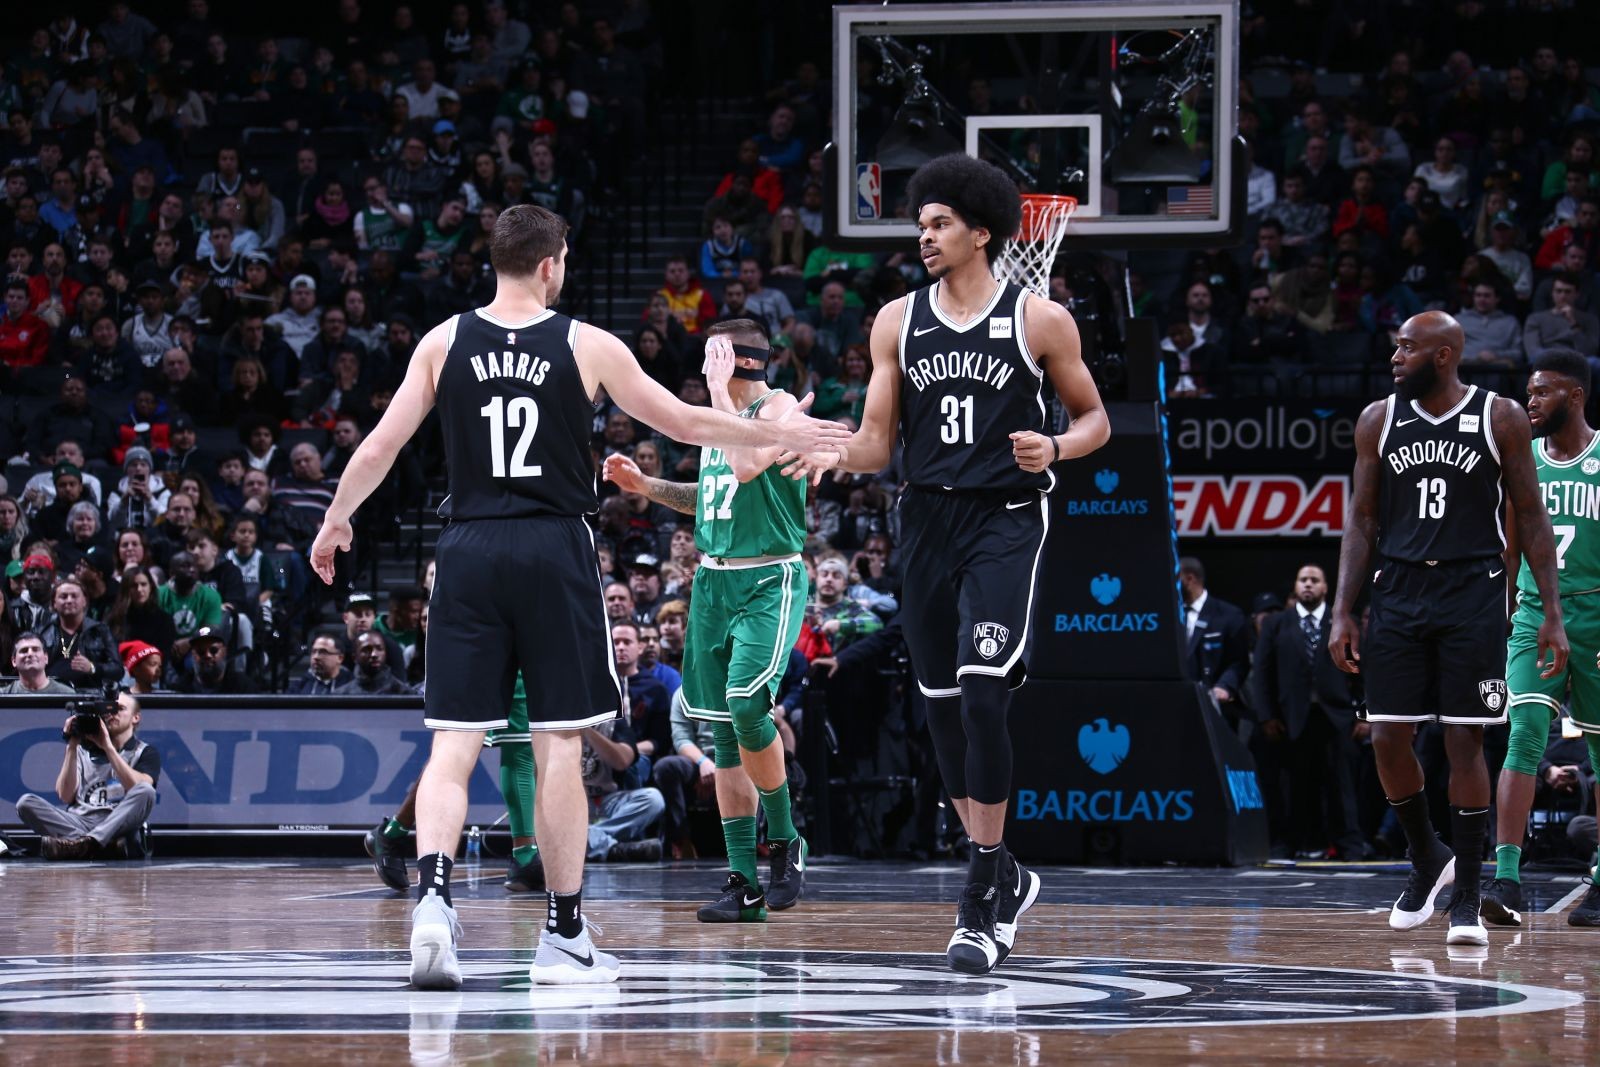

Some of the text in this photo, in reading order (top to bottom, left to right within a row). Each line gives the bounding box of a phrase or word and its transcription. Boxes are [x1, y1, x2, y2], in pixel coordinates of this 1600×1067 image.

[470, 351, 551, 386] HARRIS
[908, 351, 1014, 392] BROOKLYN
[481, 396, 542, 477] 12
[940, 395, 974, 444] 31
[1387, 440, 1481, 475] BROOKLYN
[703, 474, 739, 522] 27
[1067, 500, 1148, 515] BARCLAYS
[1416, 478, 1447, 519] 13
[1539, 481, 1600, 521] STON
[1553, 525, 1576, 569] 7
[975, 625, 1007, 642] NETS
[1055, 614, 1158, 632] BARCLAYS
[1481, 681, 1505, 694] NETS
[1016, 790, 1193, 821] BARCLAYS
